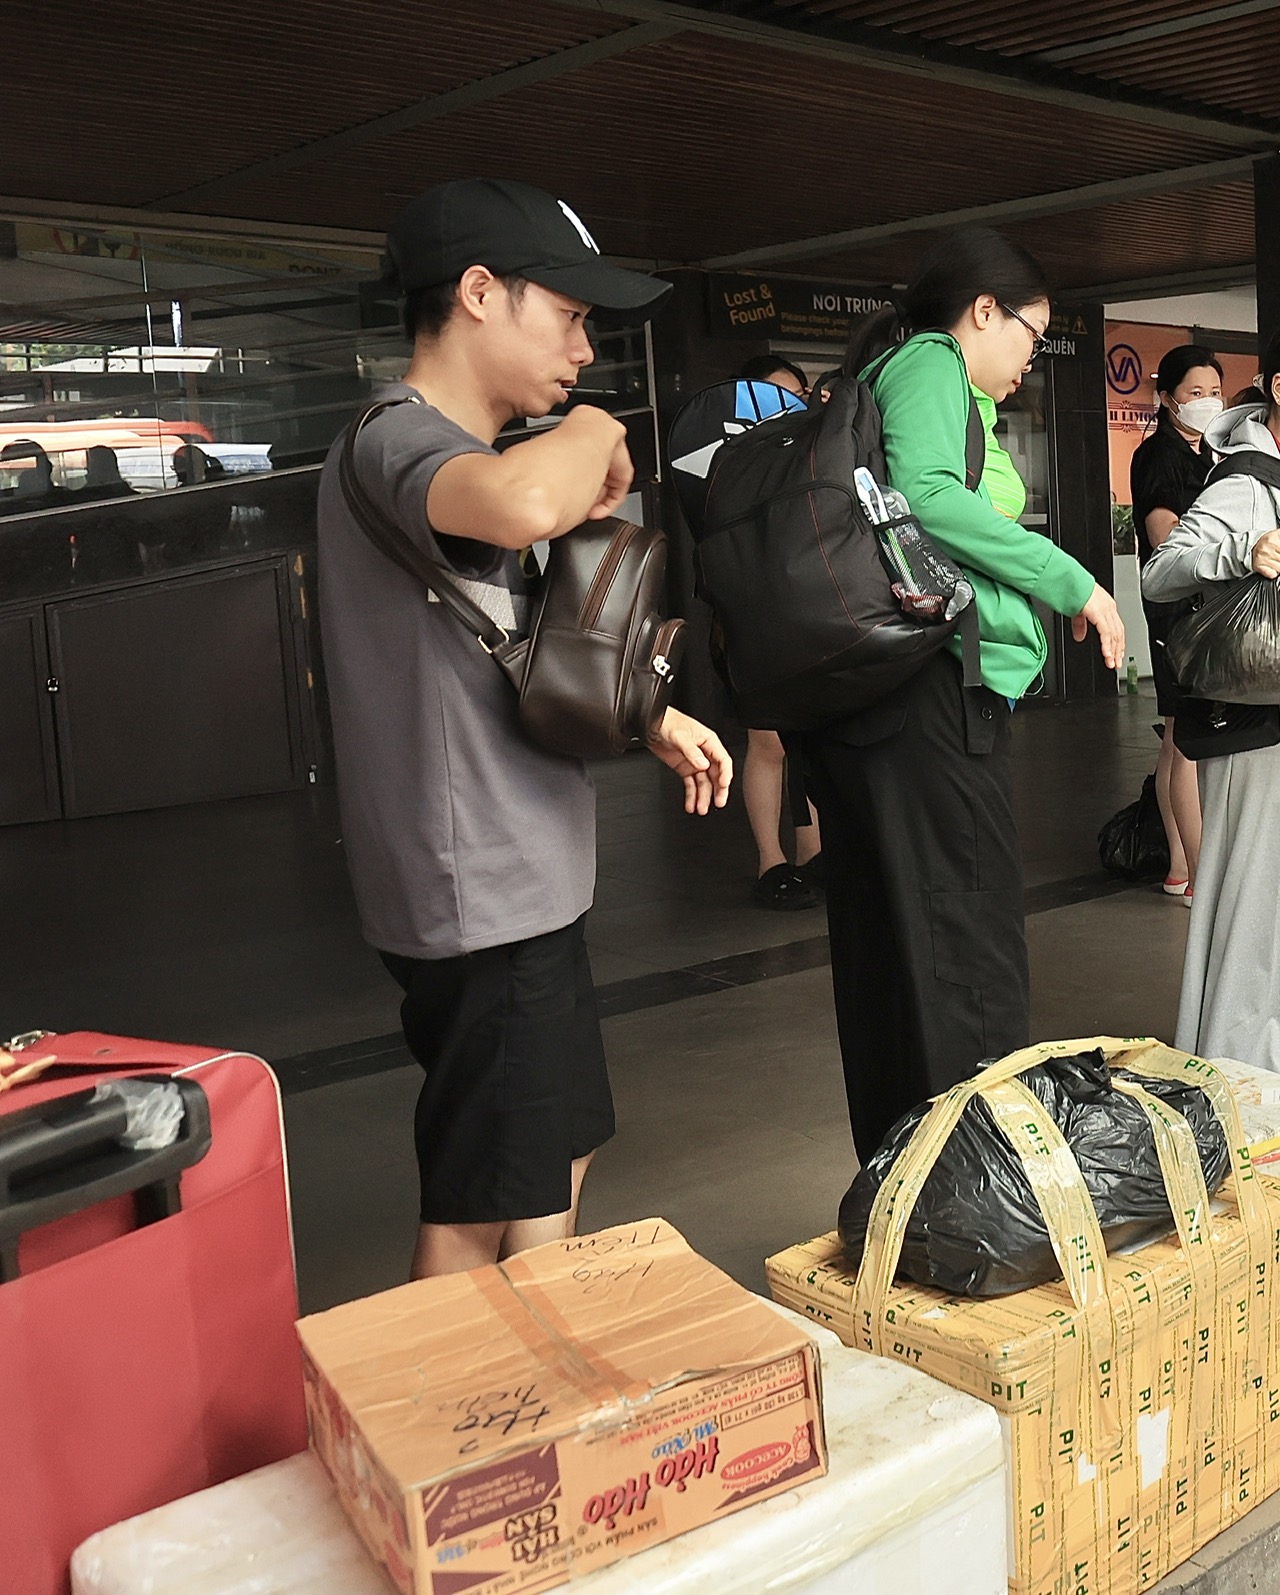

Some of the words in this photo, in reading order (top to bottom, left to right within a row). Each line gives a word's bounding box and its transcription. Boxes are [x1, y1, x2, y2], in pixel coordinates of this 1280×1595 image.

[723, 287, 756, 308] Lost
[760, 283, 773, 300] &
[728, 303, 776, 326] Found
[1044, 336, 1075, 356] QUÊN
[1184, 1058, 1216, 1078] PIT
[1185, 1208, 1202, 1245] PIT
[1072, 1235, 1096, 1273] PIT
[1125, 1270, 1151, 1304] PIT
[885, 1299, 915, 1325] PIT
[1046, 1309, 1077, 1339] PIT
[1198, 1327, 1210, 1364] PIT
[991, 1379, 1028, 1402] PIT
[1139, 1386, 1151, 1413] PI
[1269, 1388, 1280, 1422] PIT
[652, 1428, 692, 1460] Xào
[693, 1419, 717, 1440] Mì
[656, 1436, 721, 1493] Hảo
[582, 1471, 651, 1529] Hảo
[1176, 1478, 1188, 1515] PIT
[1239, 1467, 1251, 1502] PIT
[505, 1503, 556, 1538] SẢN
[511, 1525, 559, 1565] HẢI
